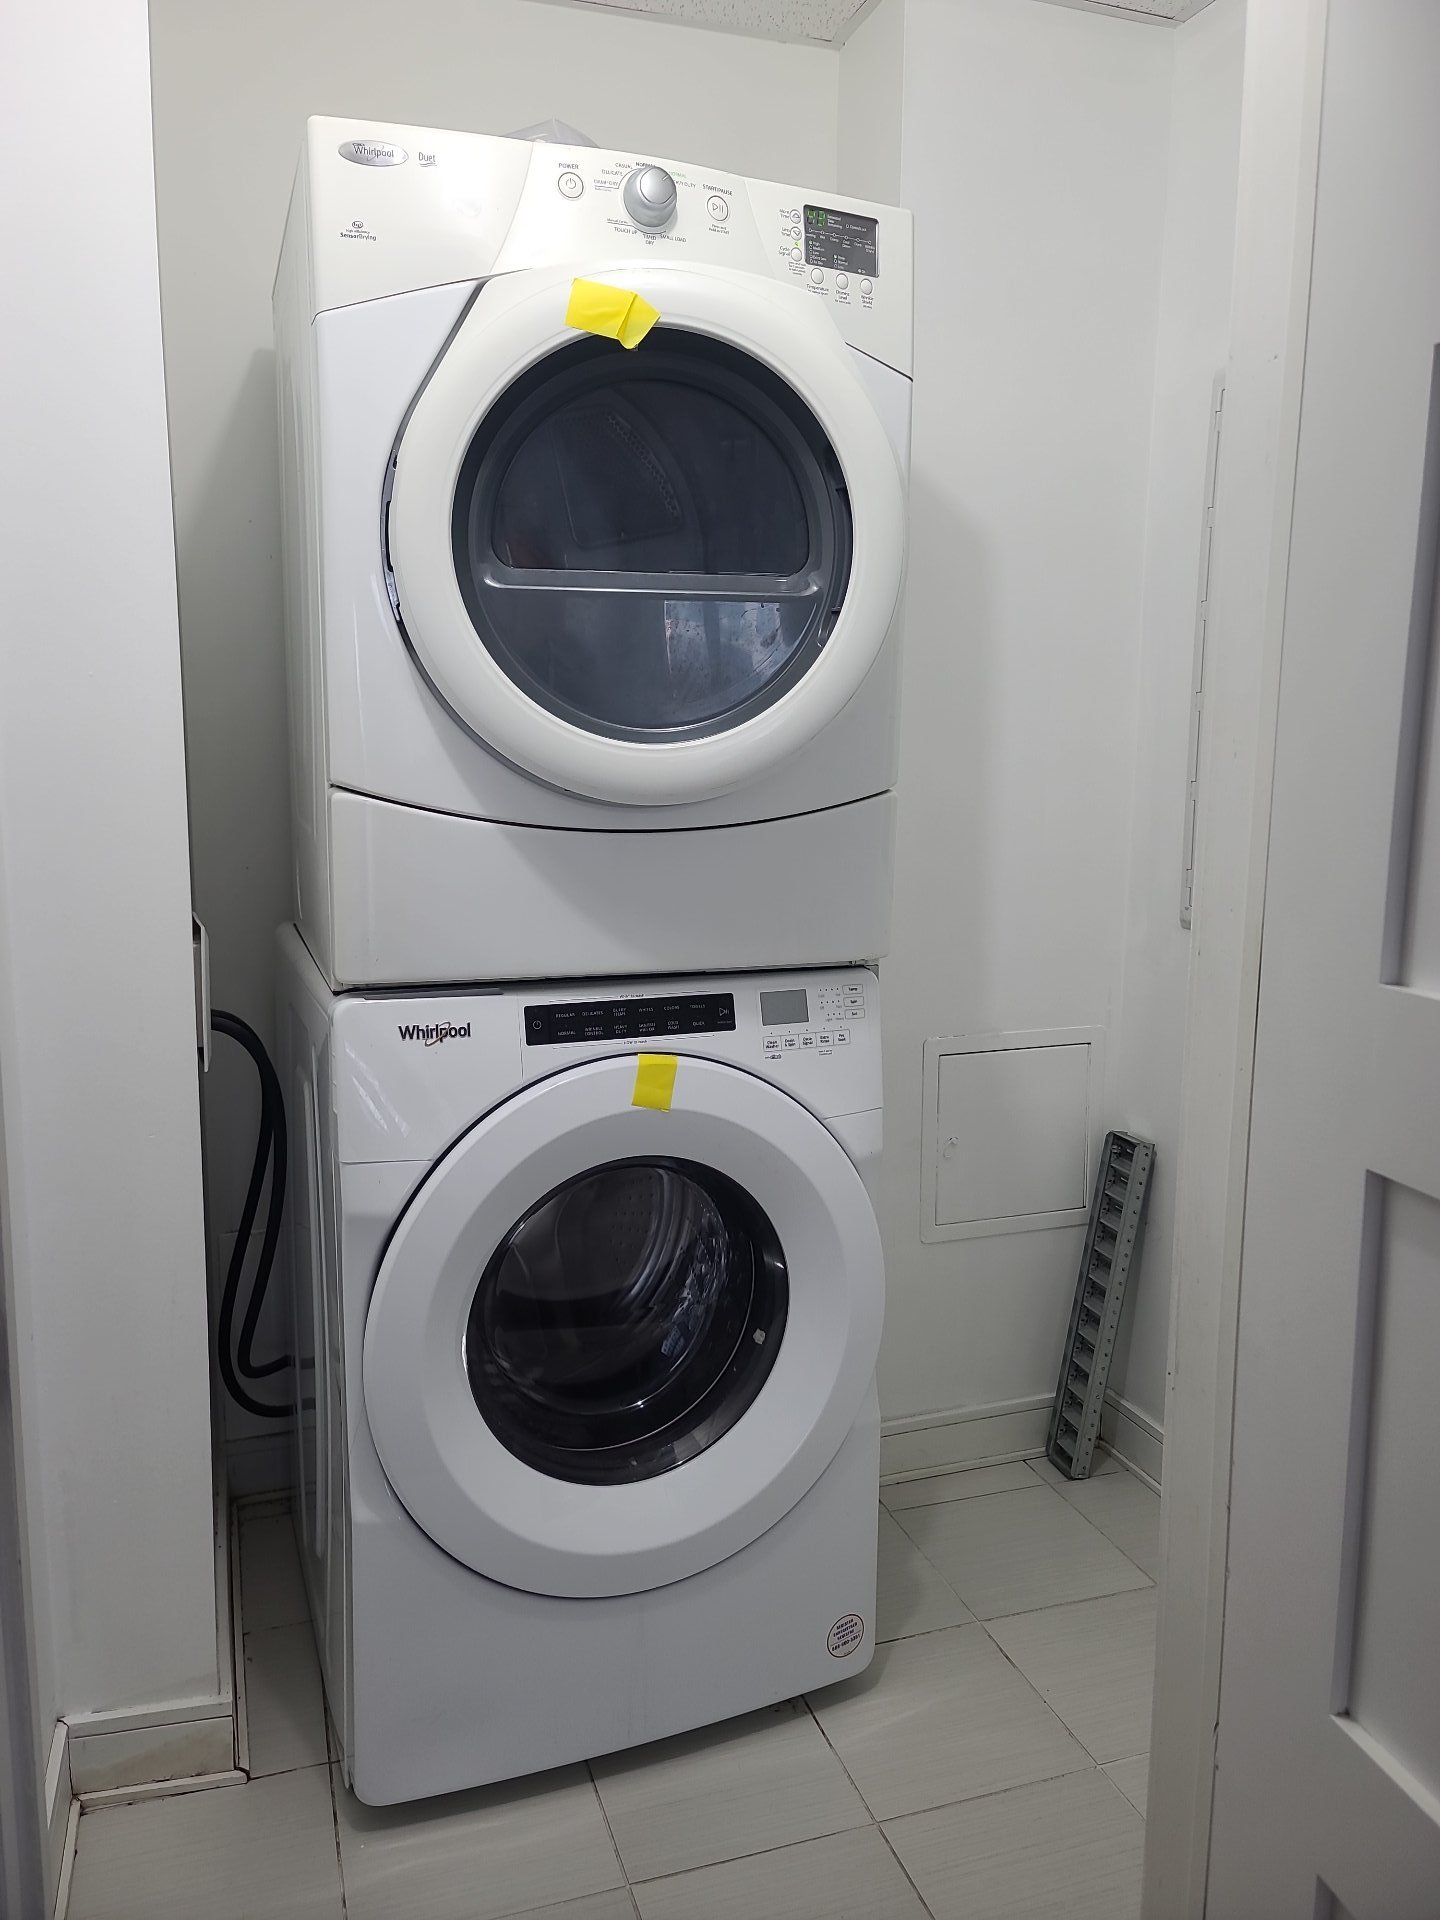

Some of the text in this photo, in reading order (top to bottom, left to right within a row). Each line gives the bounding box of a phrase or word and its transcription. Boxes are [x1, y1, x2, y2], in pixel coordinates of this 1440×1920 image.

[354, 145, 394, 159] Whirlpool
[418, 151, 436, 162] Duet
[558, 162, 579, 170] POWER
[702, 184, 733, 196] START/PAUSE
[398, 1022, 471, 1043] Whirlpool
